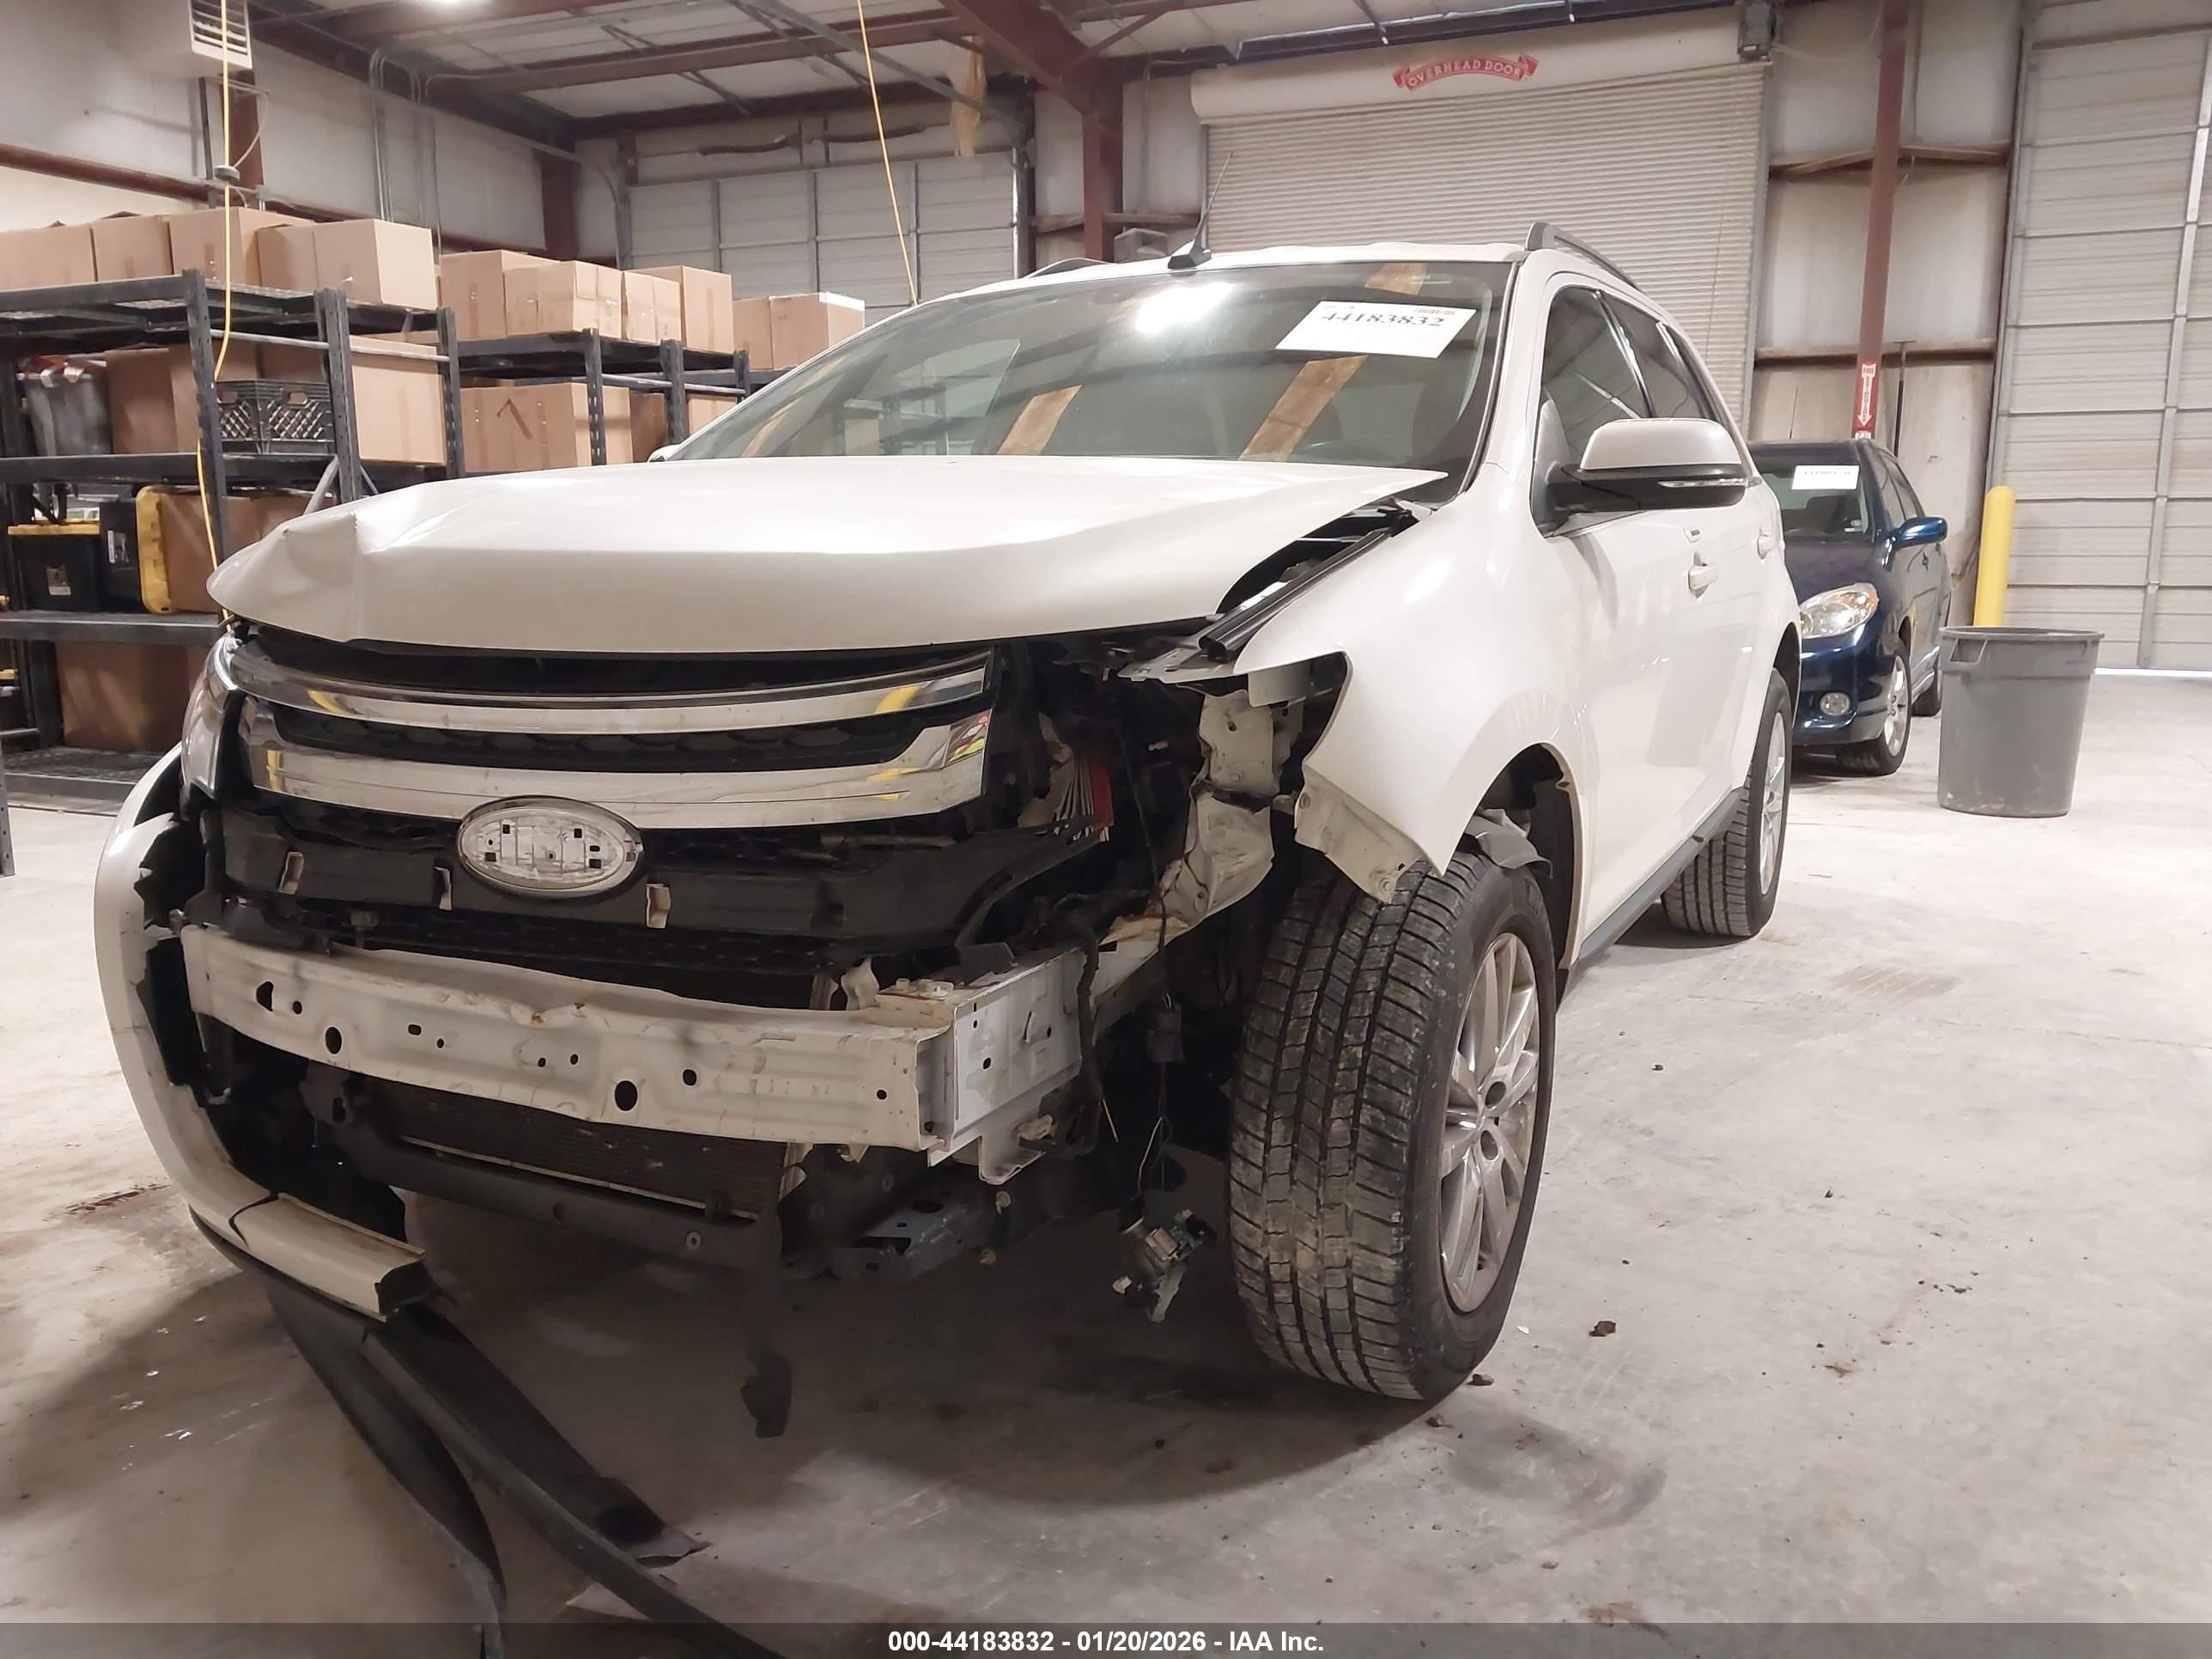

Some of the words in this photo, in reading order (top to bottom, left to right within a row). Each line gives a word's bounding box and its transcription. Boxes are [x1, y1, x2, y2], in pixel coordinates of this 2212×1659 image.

[1407, 59, 1481, 87] OVERHEAD
[1485, 60, 1522, 77] DOOR
[1321, 312, 1447, 327] 44183832
